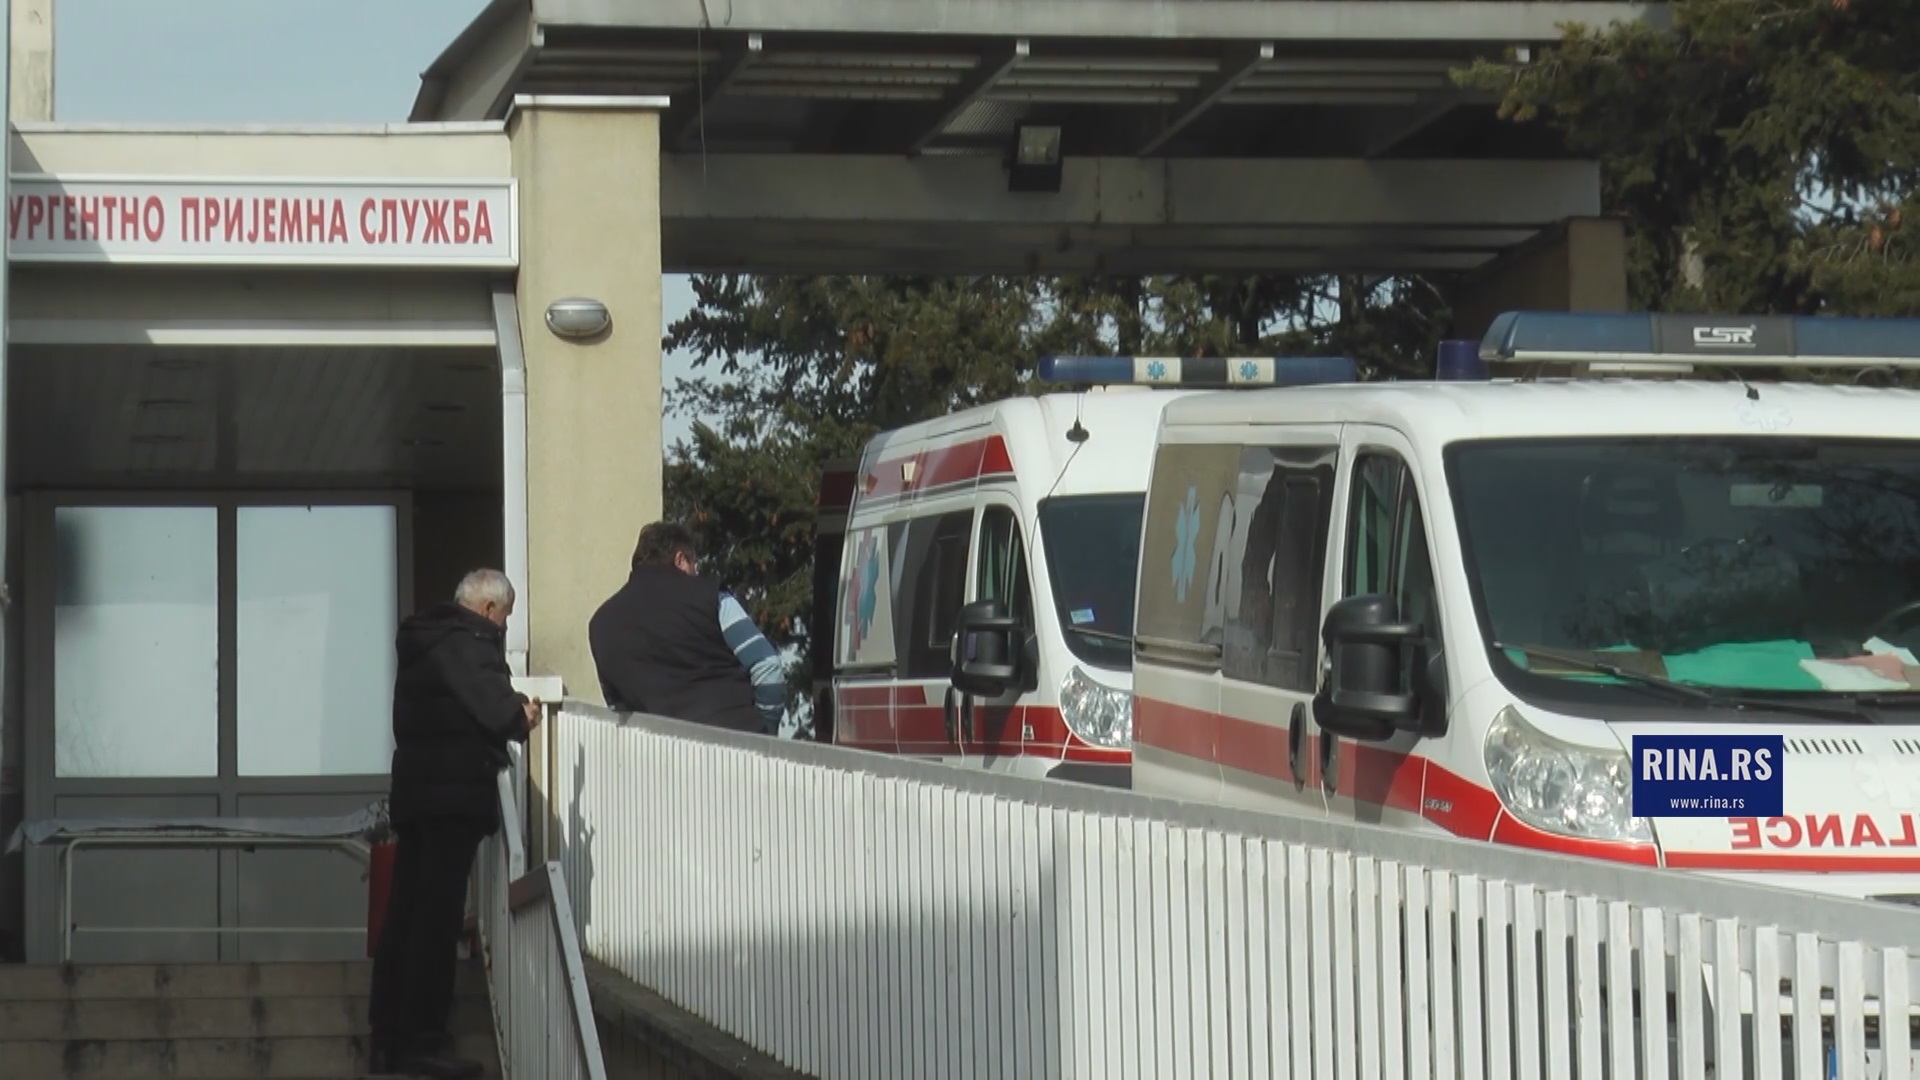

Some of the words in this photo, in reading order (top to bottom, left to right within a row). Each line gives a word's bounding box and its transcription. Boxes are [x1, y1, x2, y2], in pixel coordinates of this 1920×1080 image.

[9, 194, 165, 242] УРГЕНТНО
[181, 196, 348, 245] ПРИЈЕМНА
[359, 198, 493, 245] СЛУЖБА
[1693, 327, 1753, 342] CSR
